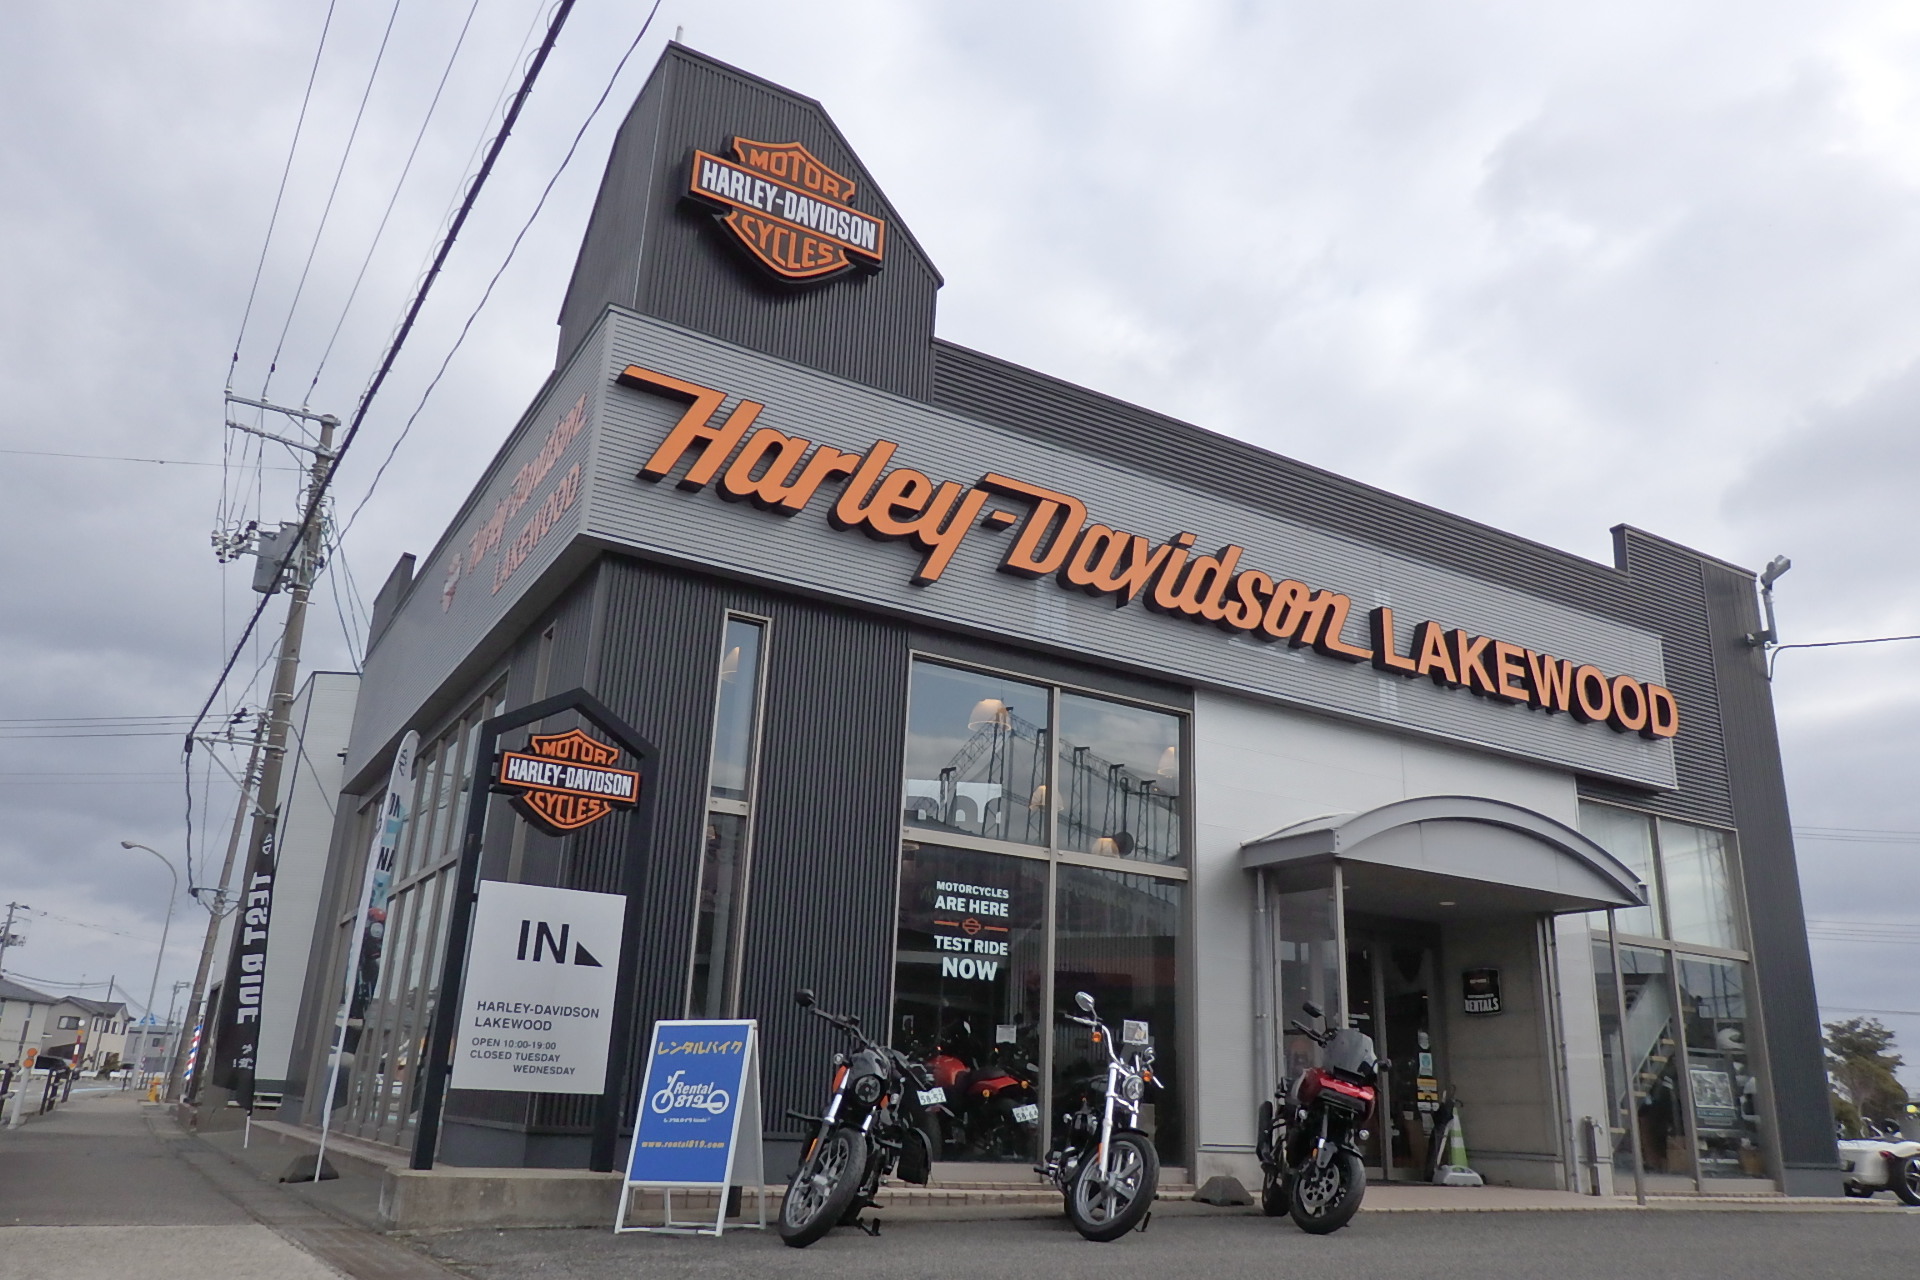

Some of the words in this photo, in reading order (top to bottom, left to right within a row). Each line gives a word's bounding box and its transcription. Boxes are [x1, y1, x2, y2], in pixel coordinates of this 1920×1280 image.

[750, 149, 840, 198] MOTOR
[701, 160, 876, 250] HARLEY-DAVIDSON
[741, 214, 834, 269] CYCLES
[615, 364, 1374, 663] Harley-Davidson
[1374, 606, 1678, 738] LAKEWOOD
[542, 735, 607, 764] MOTOR
[507, 757, 633, 796] HARLEY-DAVIDSON
[534, 792, 601, 823] CYCLES
[936, 880, 1010, 899] MOTORCYCLES
[934, 895, 967, 912] ARE
[968, 899, 1009, 917] HERE
[516, 919, 570, 965] IN
[933, 935, 972, 952] TEST
[974, 939, 1009, 956] RIDE
[941, 956, 998, 981] NOW
[476, 1000, 600, 1019] HARLEY-DAVIDSON
[474, 1016, 553, 1031] LAKEWOOD
[471, 1037, 501, 1047] OPEN
[503, 1039, 557, 1050] 10:00-19:00
[657, 1041, 743, 1055] レンタルバイク
[470, 1049, 512, 1060] CLOSED
[515, 1052, 561, 1063] TUESDAY
[513, 1064, 576, 1075] WEDNESDAY
[673, 1081, 714, 1095] Rental
[674, 1094, 705, 1108] 819
